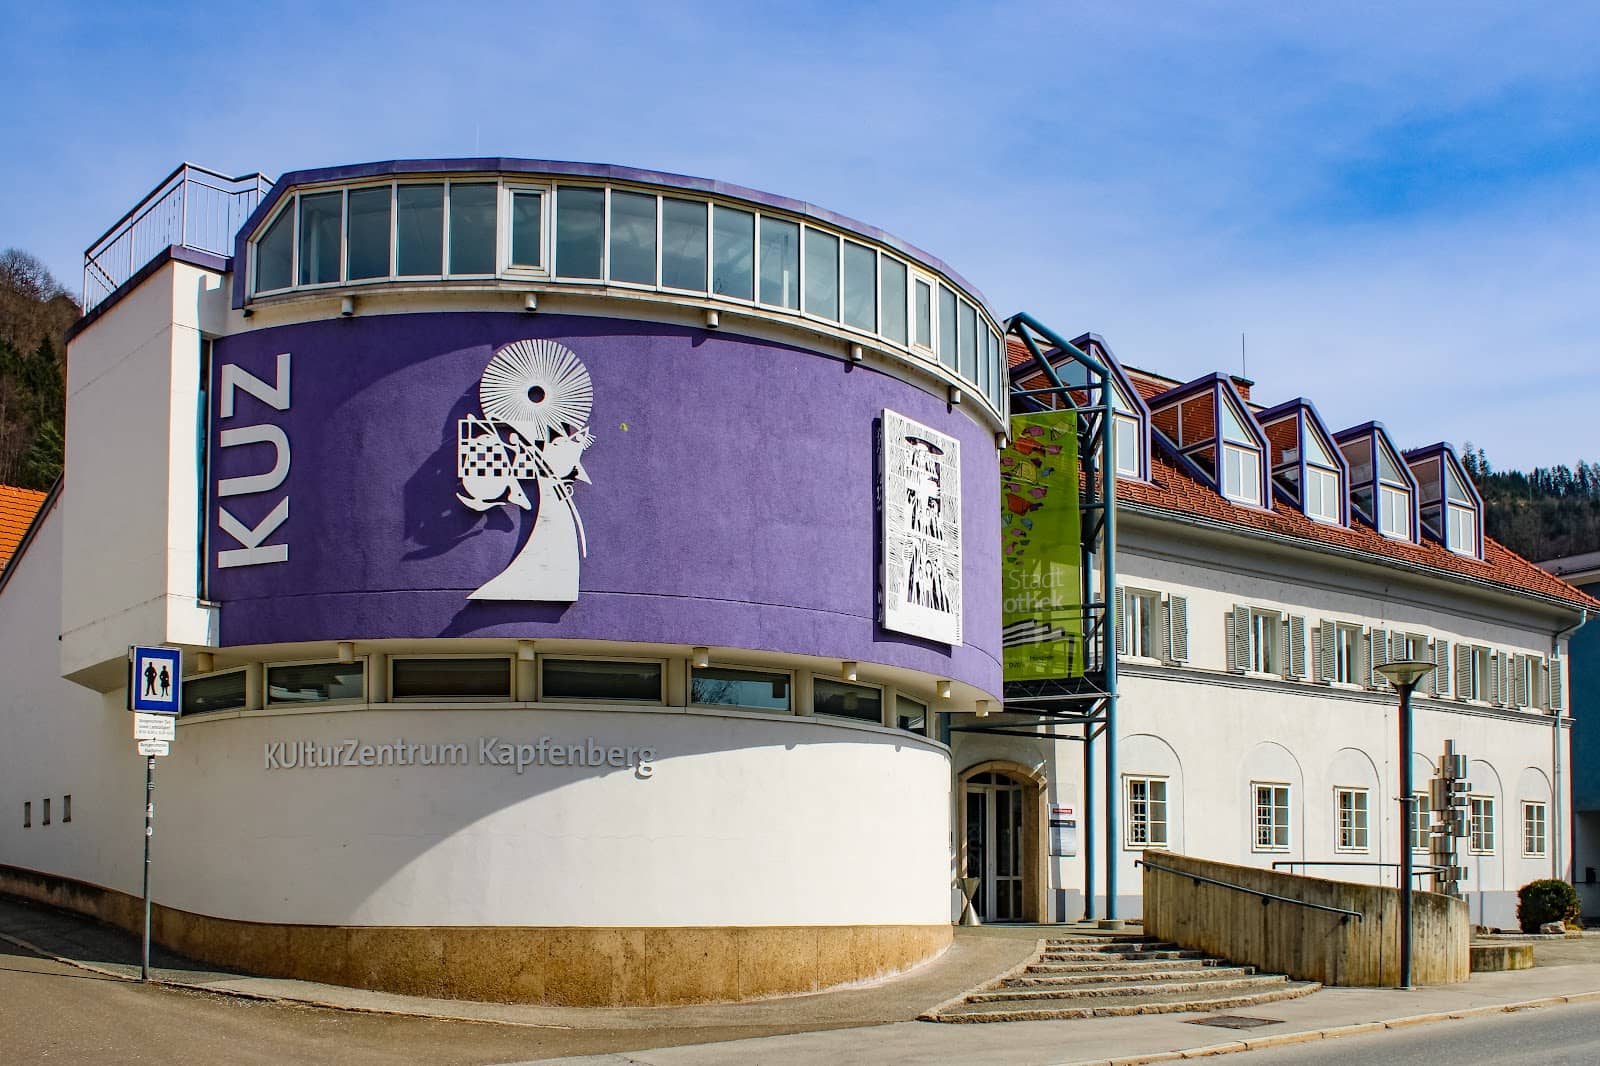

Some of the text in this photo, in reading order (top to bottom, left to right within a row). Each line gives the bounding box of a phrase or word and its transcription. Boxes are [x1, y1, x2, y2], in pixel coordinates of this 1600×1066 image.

[218, 352, 291, 568] KUZ
[1008, 570, 1065, 590] Stadt
[1004, 592, 1065, 613] othek
[264, 735, 657, 779] KUlturZentrum Kapfenberg
